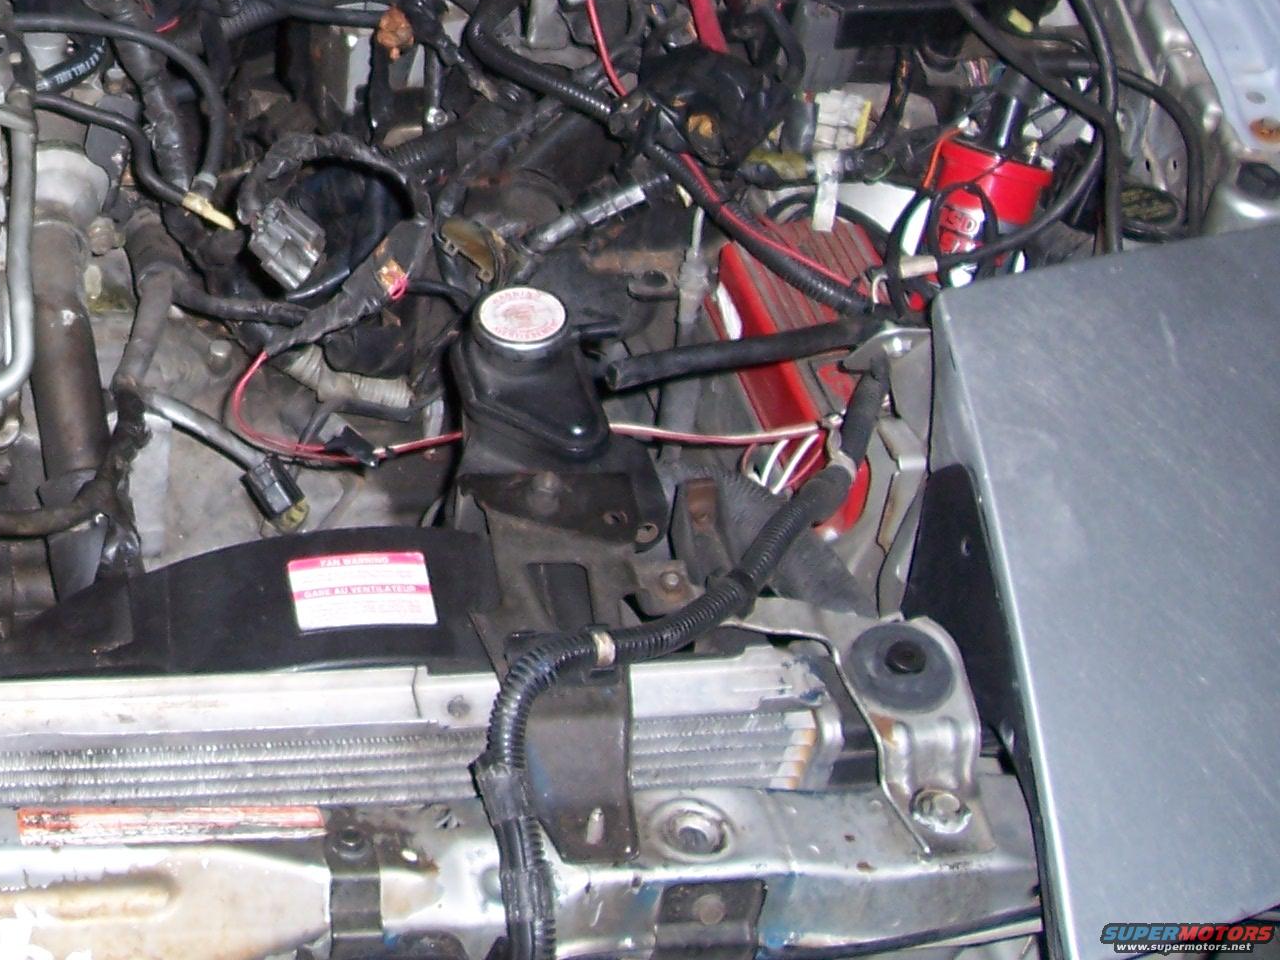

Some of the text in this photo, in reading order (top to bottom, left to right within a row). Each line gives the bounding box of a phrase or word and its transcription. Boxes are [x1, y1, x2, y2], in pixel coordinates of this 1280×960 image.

[342, 556, 389, 567] WARNING
[334, 586, 348, 596] AU
[351, 584, 417, 595] VENTILATEUR
